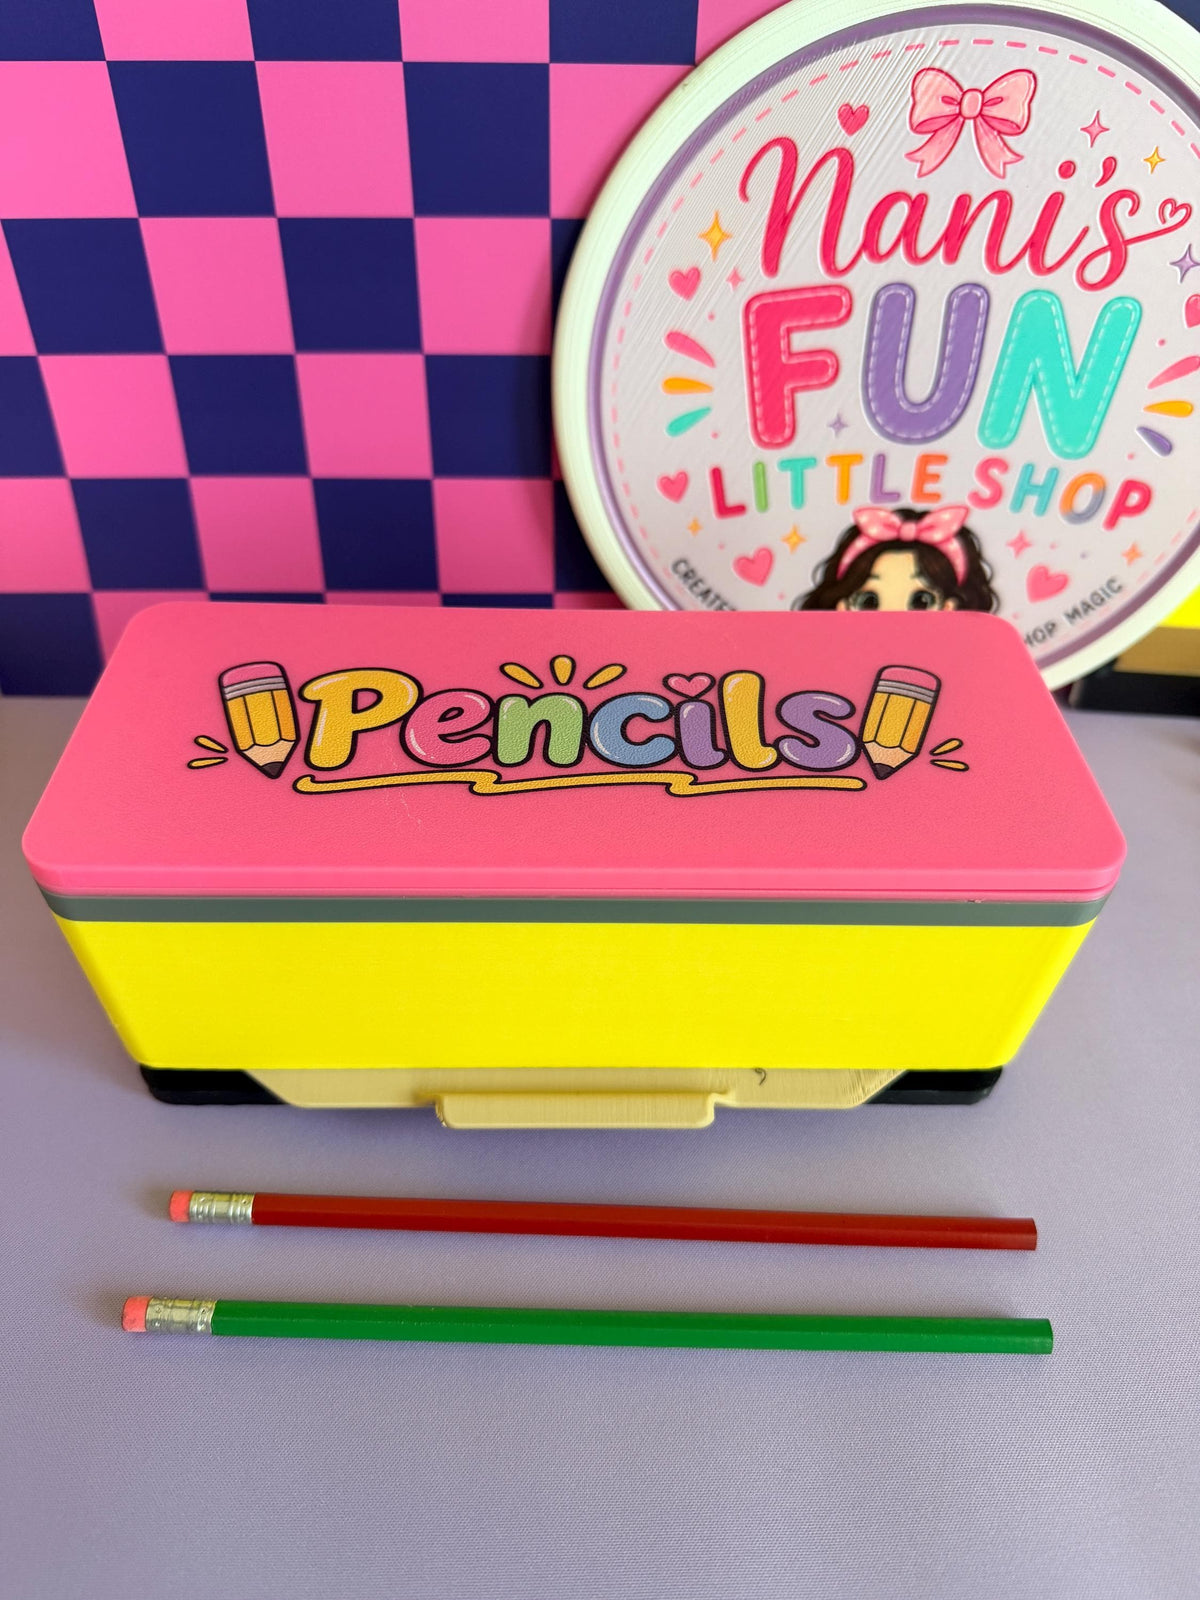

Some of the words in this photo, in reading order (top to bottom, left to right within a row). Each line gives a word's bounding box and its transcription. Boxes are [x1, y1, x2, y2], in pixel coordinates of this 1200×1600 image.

[742, 282, 1143, 460] FUN
[709, 453, 948, 519] LITTLE
[967, 457, 1152, 531] SHOP
[1063, 576, 1123, 624] MAGIC
[300, 667, 857, 771] Pencils
